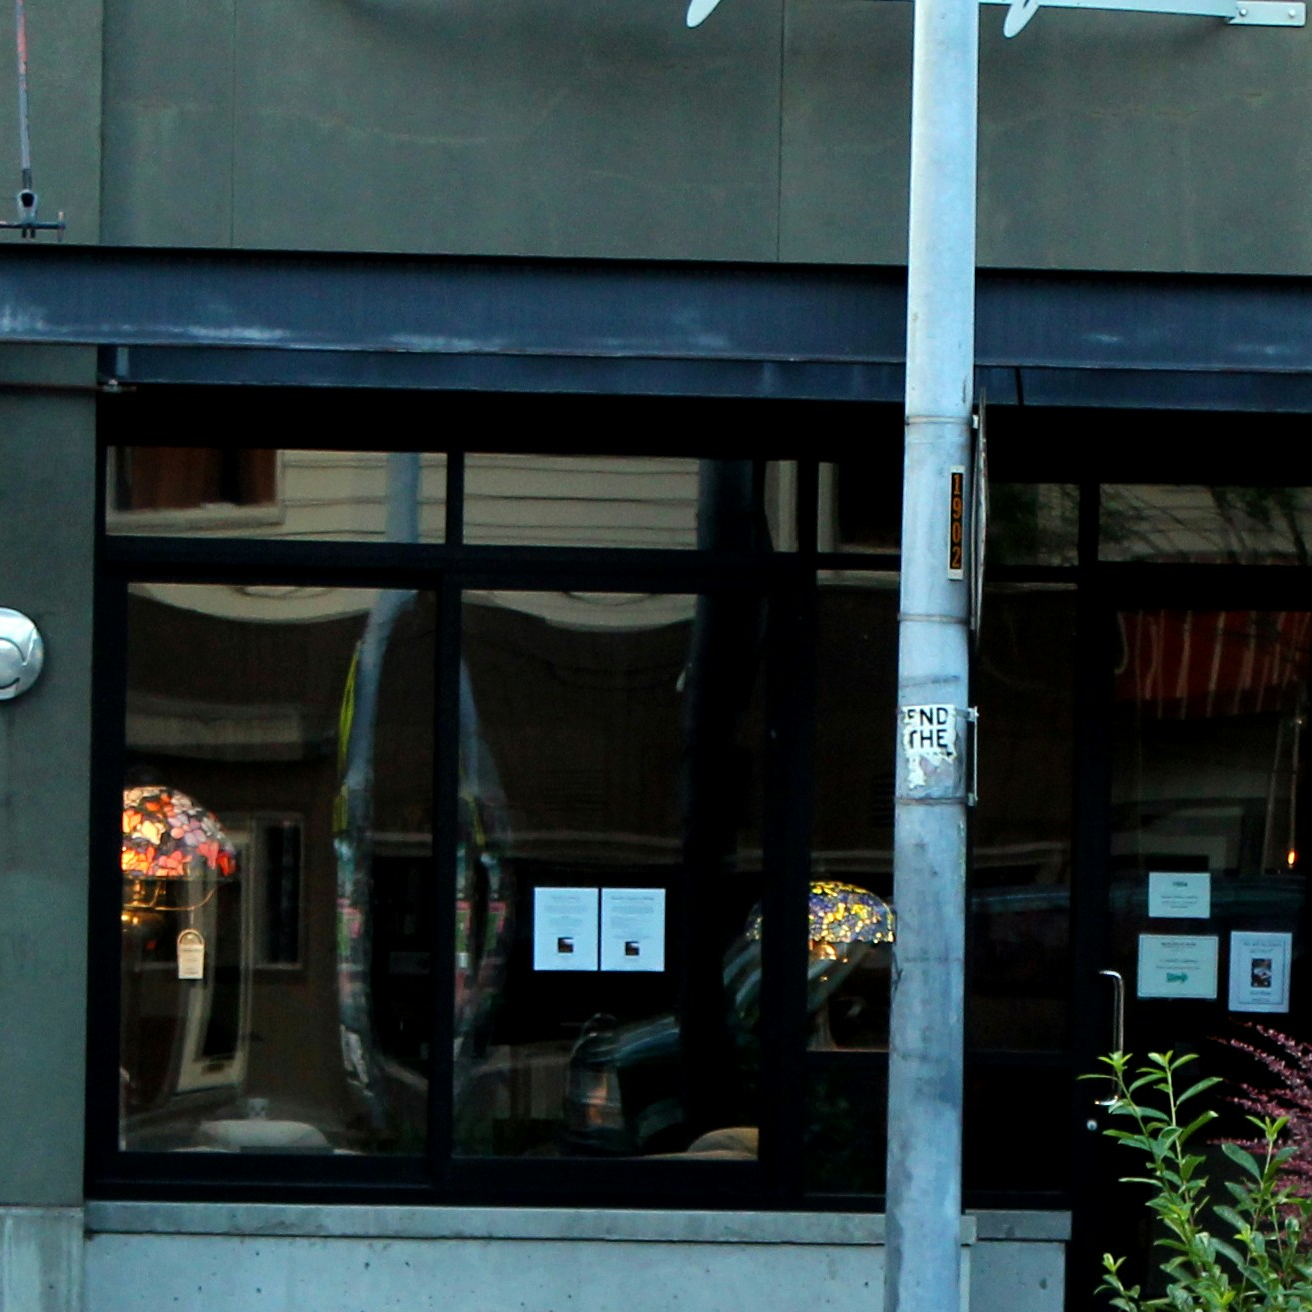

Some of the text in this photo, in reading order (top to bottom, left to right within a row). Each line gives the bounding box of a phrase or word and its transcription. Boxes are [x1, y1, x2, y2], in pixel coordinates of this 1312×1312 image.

[951, 474, 962, 569] 1902
[907, 707, 948, 726] END
[909, 729, 948, 749] THE
